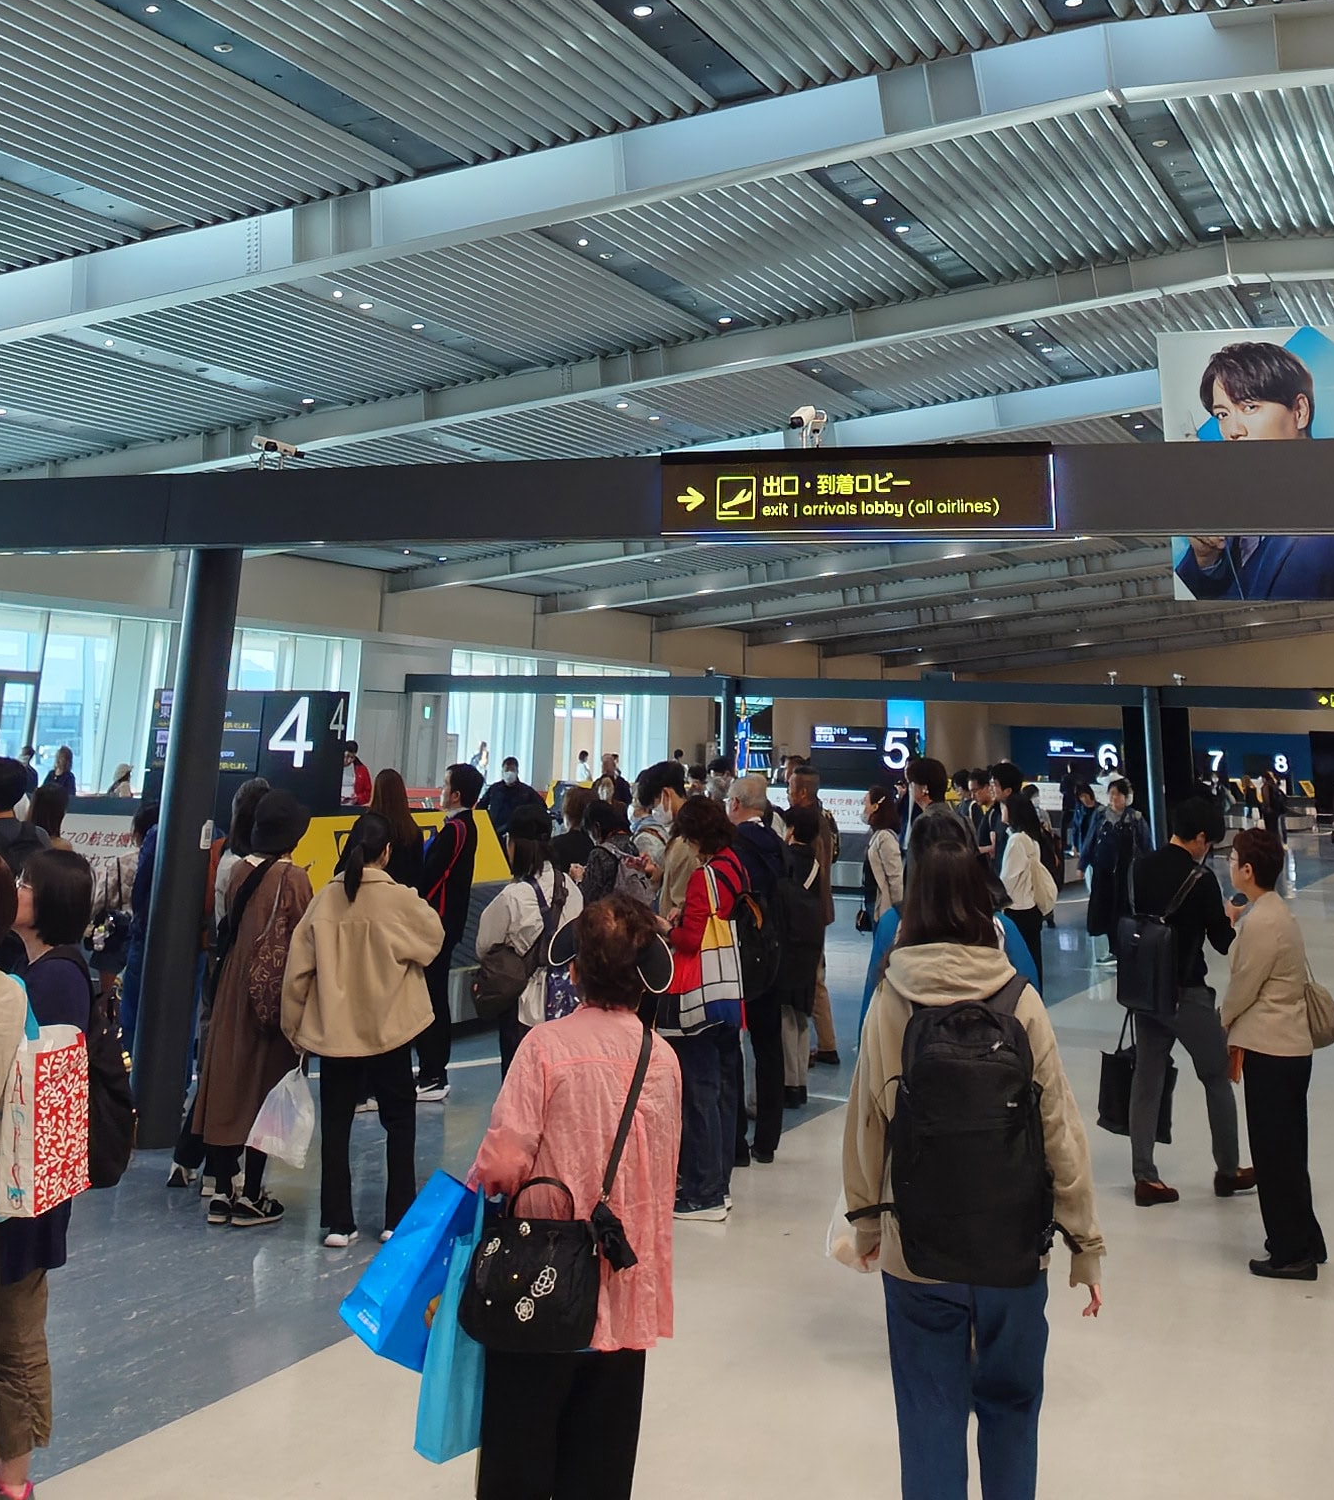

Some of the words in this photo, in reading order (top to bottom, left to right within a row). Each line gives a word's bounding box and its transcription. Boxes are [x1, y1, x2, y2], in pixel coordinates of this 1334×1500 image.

[762, 472, 912, 497] 出口・到着ロビー
[762, 501, 789, 517] exit
[802, 500, 858, 517] arrivals
[861, 499, 905, 518] lobby
[907, 498, 934, 518] (all
[937, 497, 1001, 517] airlines)
[328, 697, 346, 740] 4
[267, 695, 315, 769] 4
[883, 731, 911, 770] 5
[1098, 743, 1119, 770] 6
[1208, 750, 1224, 772] 7
[1274, 754, 1289, 773] 8
